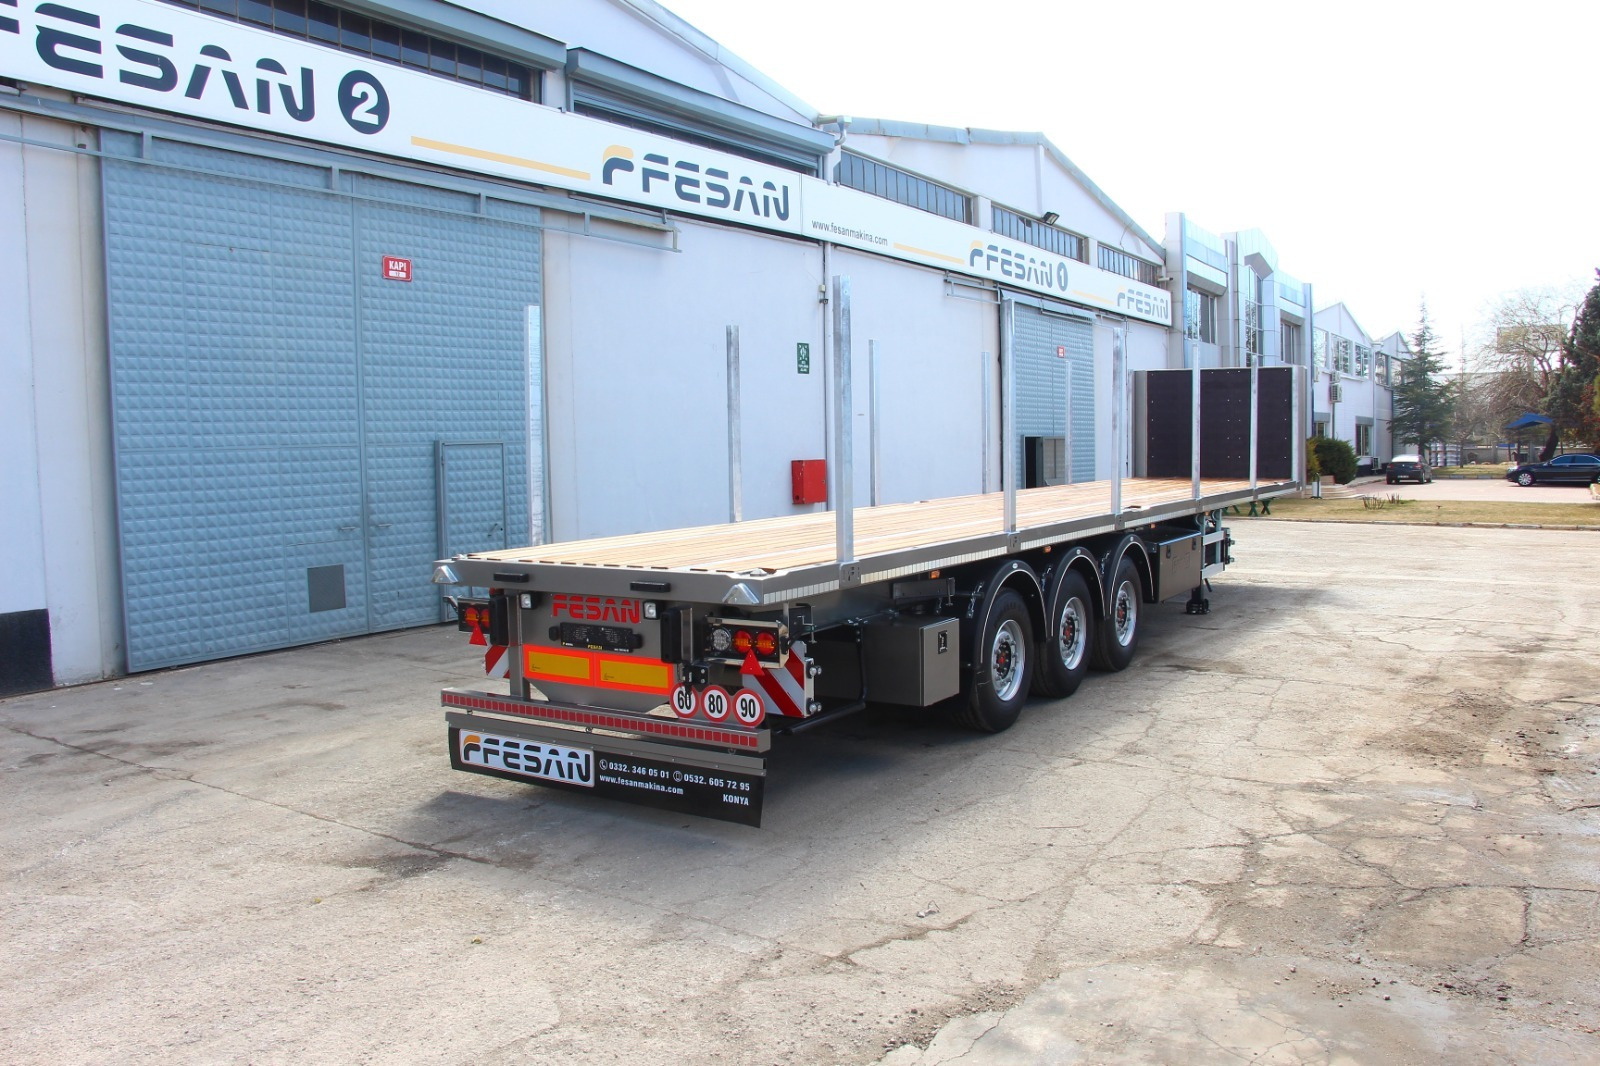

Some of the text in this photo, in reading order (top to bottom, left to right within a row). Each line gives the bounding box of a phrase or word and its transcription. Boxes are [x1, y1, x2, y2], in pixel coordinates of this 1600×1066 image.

[351, 81, 379, 126] 2
[811, 219, 888, 246] www.fesanmakina.com
[389, 261, 406, 271] KAPI
[553, 595, 640, 624] FESAN
[677, 690, 692, 710] 60
[708, 694, 723, 714] 80
[740, 698, 756, 718] 90
[608, 761, 670, 779] 0332. 346 05 01
[600, 774, 684, 795] www.fesanmakina.com
[683, 773, 750, 791] 0532. 605 72 95
[723, 794, 749, 805] KONYA
